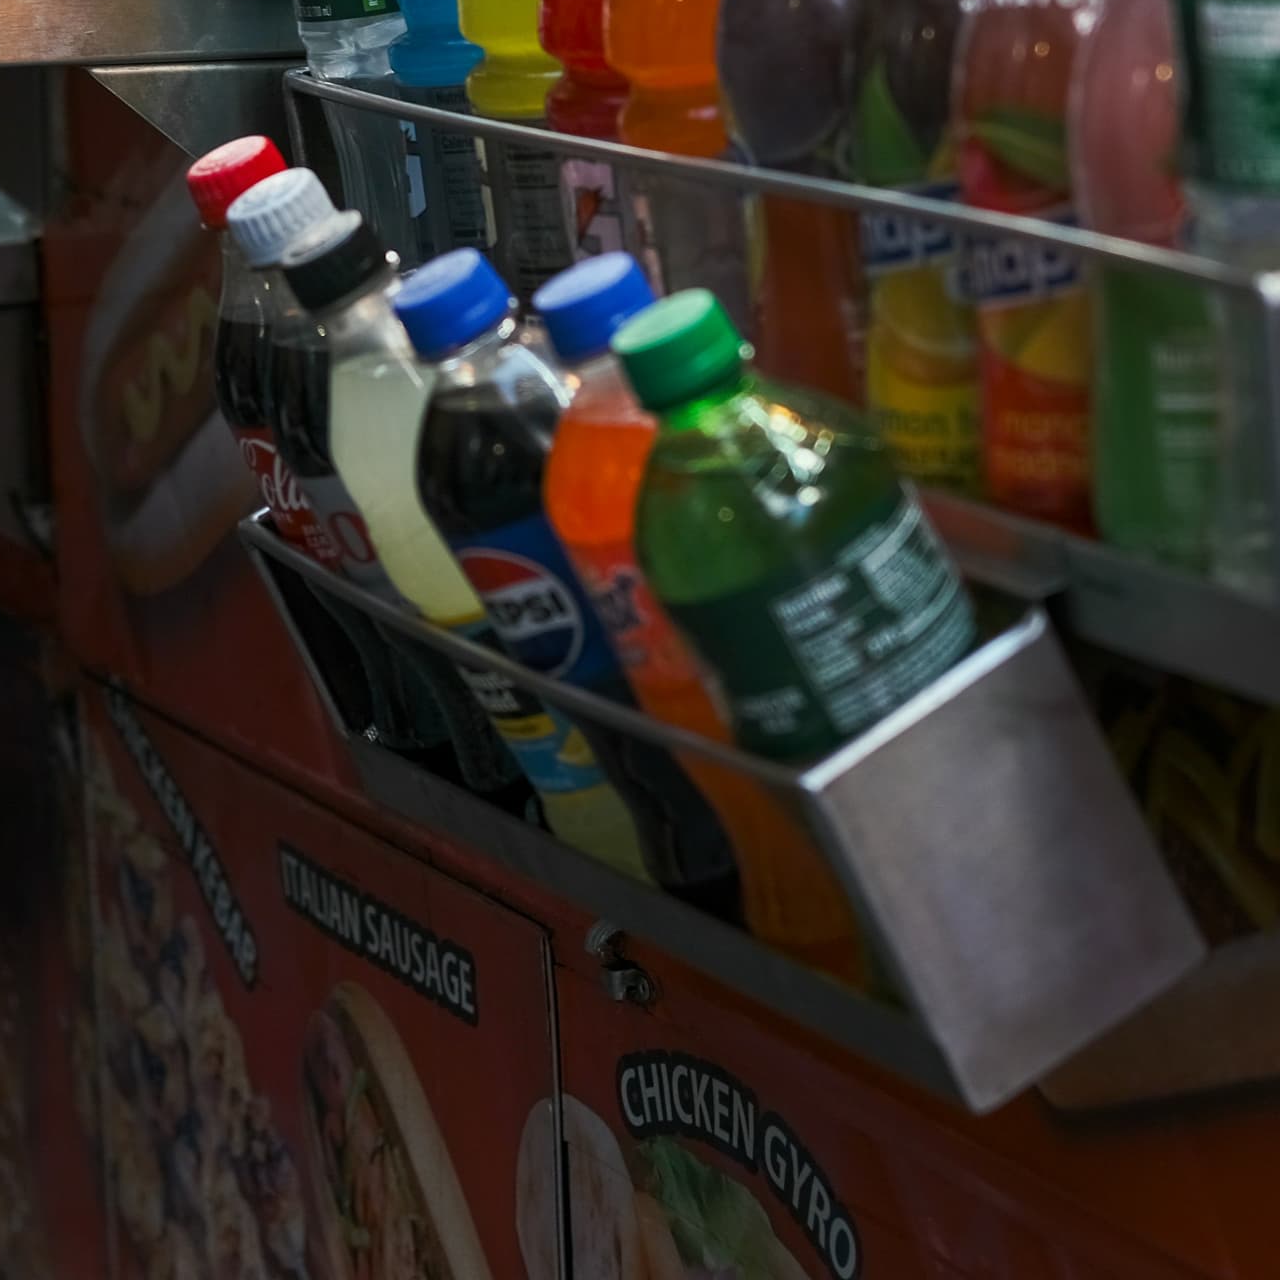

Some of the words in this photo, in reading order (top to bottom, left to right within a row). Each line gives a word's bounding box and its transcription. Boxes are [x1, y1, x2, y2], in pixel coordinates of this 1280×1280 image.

[279, 848, 362, 946] ITALIAN
[363, 903, 476, 1017] SAUSAGE
[619, 1062, 757, 1161] CHICKEN
[763, 1124, 858, 1280] GYRO
